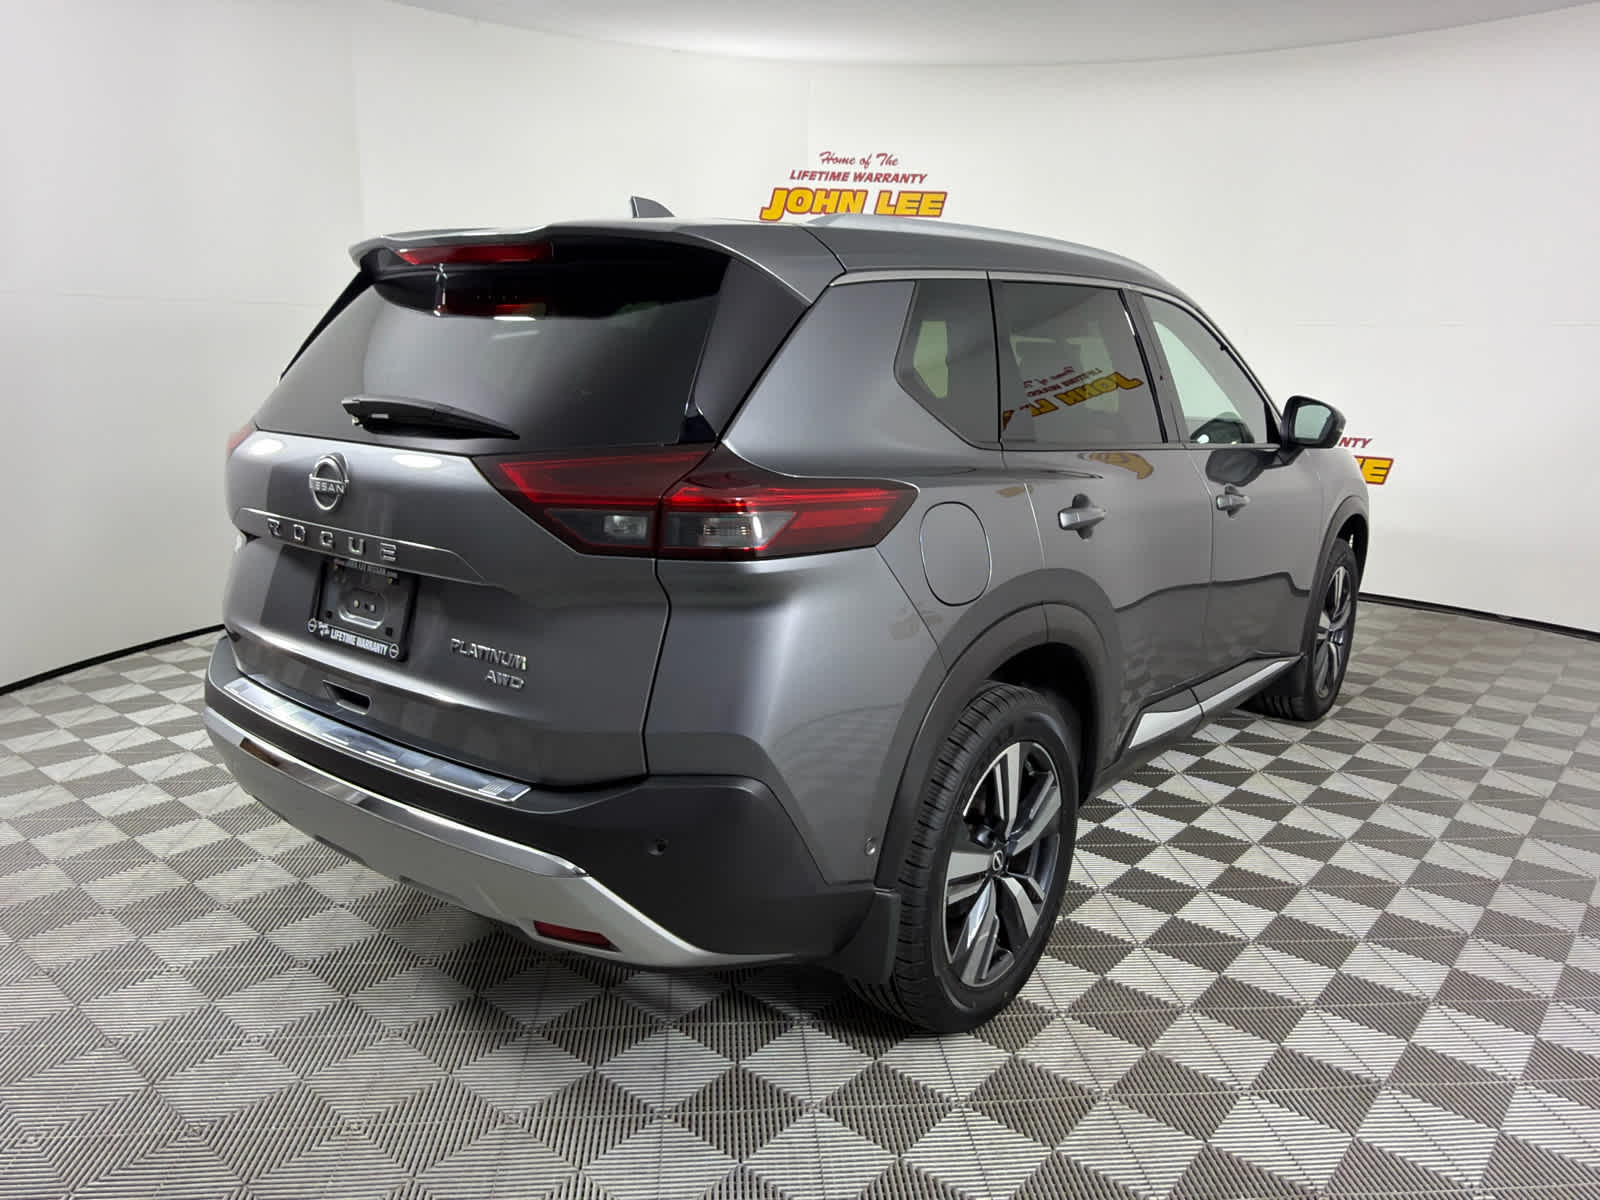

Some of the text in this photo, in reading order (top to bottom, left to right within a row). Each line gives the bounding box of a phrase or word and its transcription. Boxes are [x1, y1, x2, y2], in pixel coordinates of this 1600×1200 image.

[818, 151, 899, 169] Home of The
[789, 170, 928, 185] LIFETIME WARRANTY
[759, 187, 948, 222] JOHN LEE
[267, 517, 397, 562] ROGUE
[330, 628, 358, 646] LIFETIME
[356, 636, 388, 656] WARRANTY
[450, 638, 527, 670] PLATINUM
[484, 669, 525, 689] AWD
